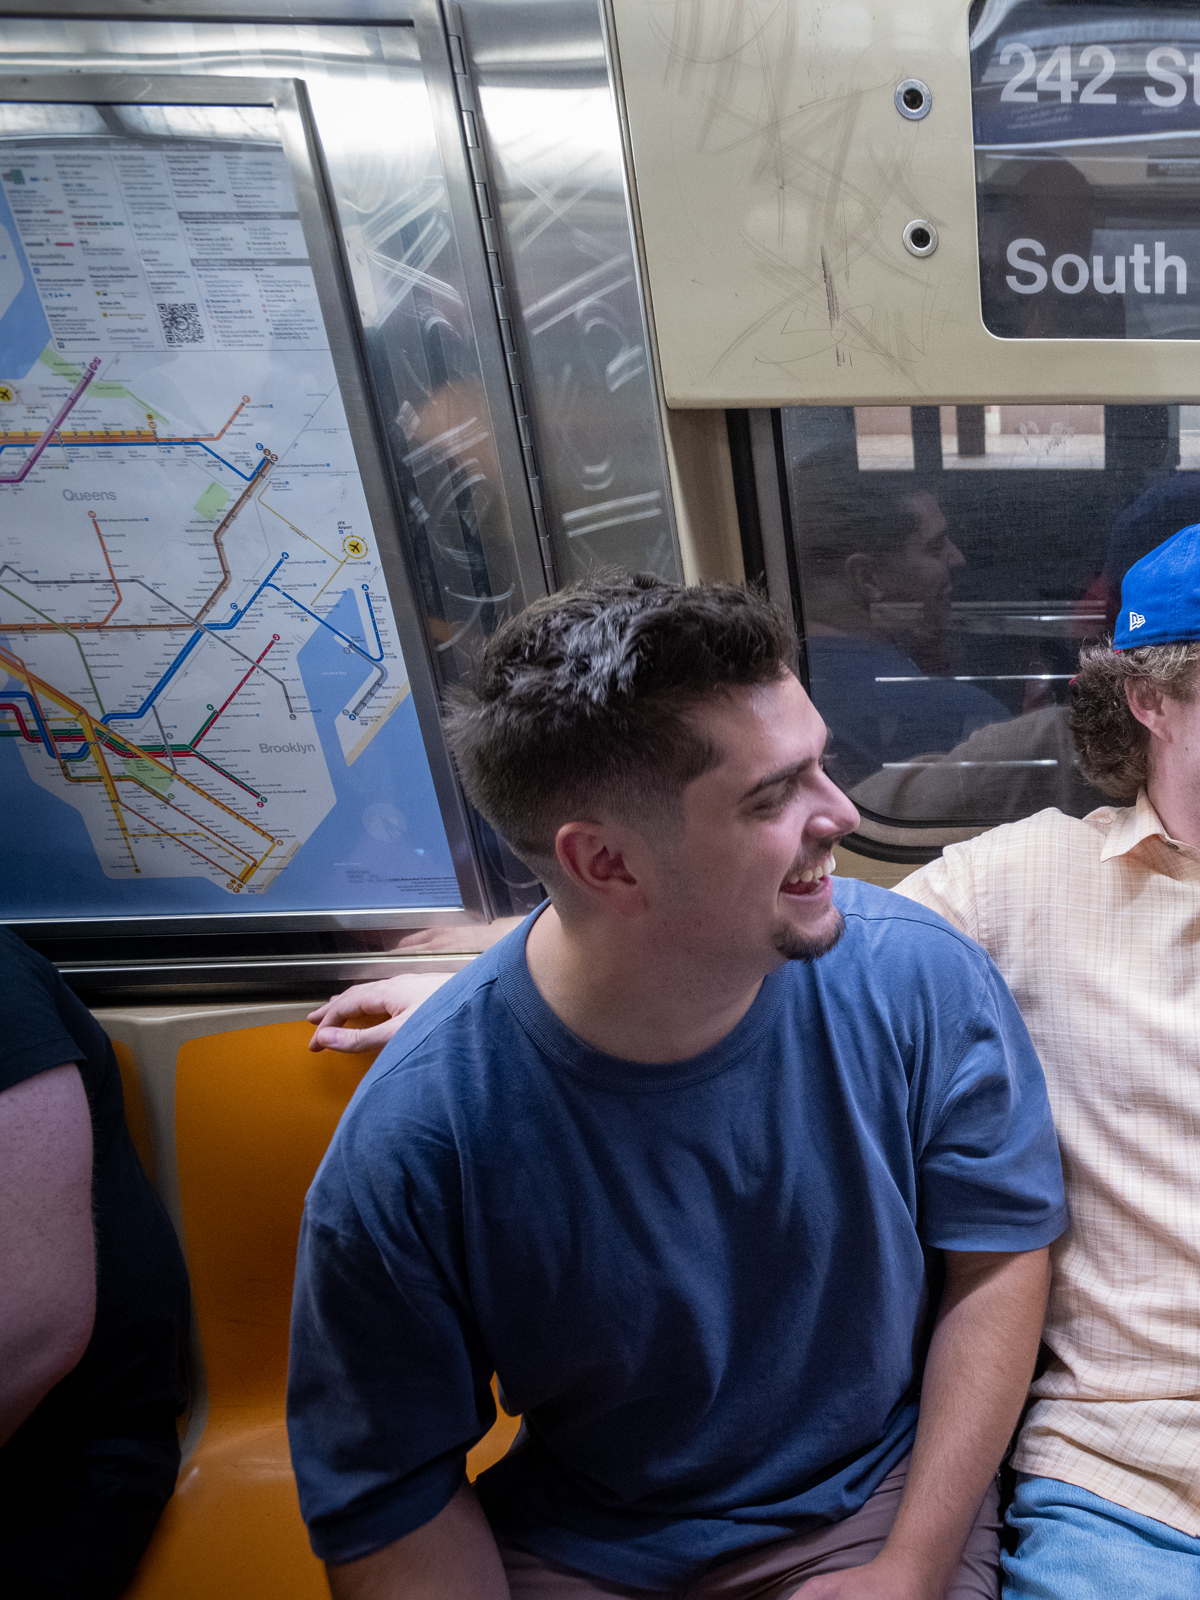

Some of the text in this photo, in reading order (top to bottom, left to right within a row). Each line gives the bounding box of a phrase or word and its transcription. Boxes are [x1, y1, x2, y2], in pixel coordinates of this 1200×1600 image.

[998, 43, 1117, 105] 242
[1005, 238, 1189, 297] South
[62, 488, 118, 502] Queens
[259, 741, 316, 756] Brooklyn
